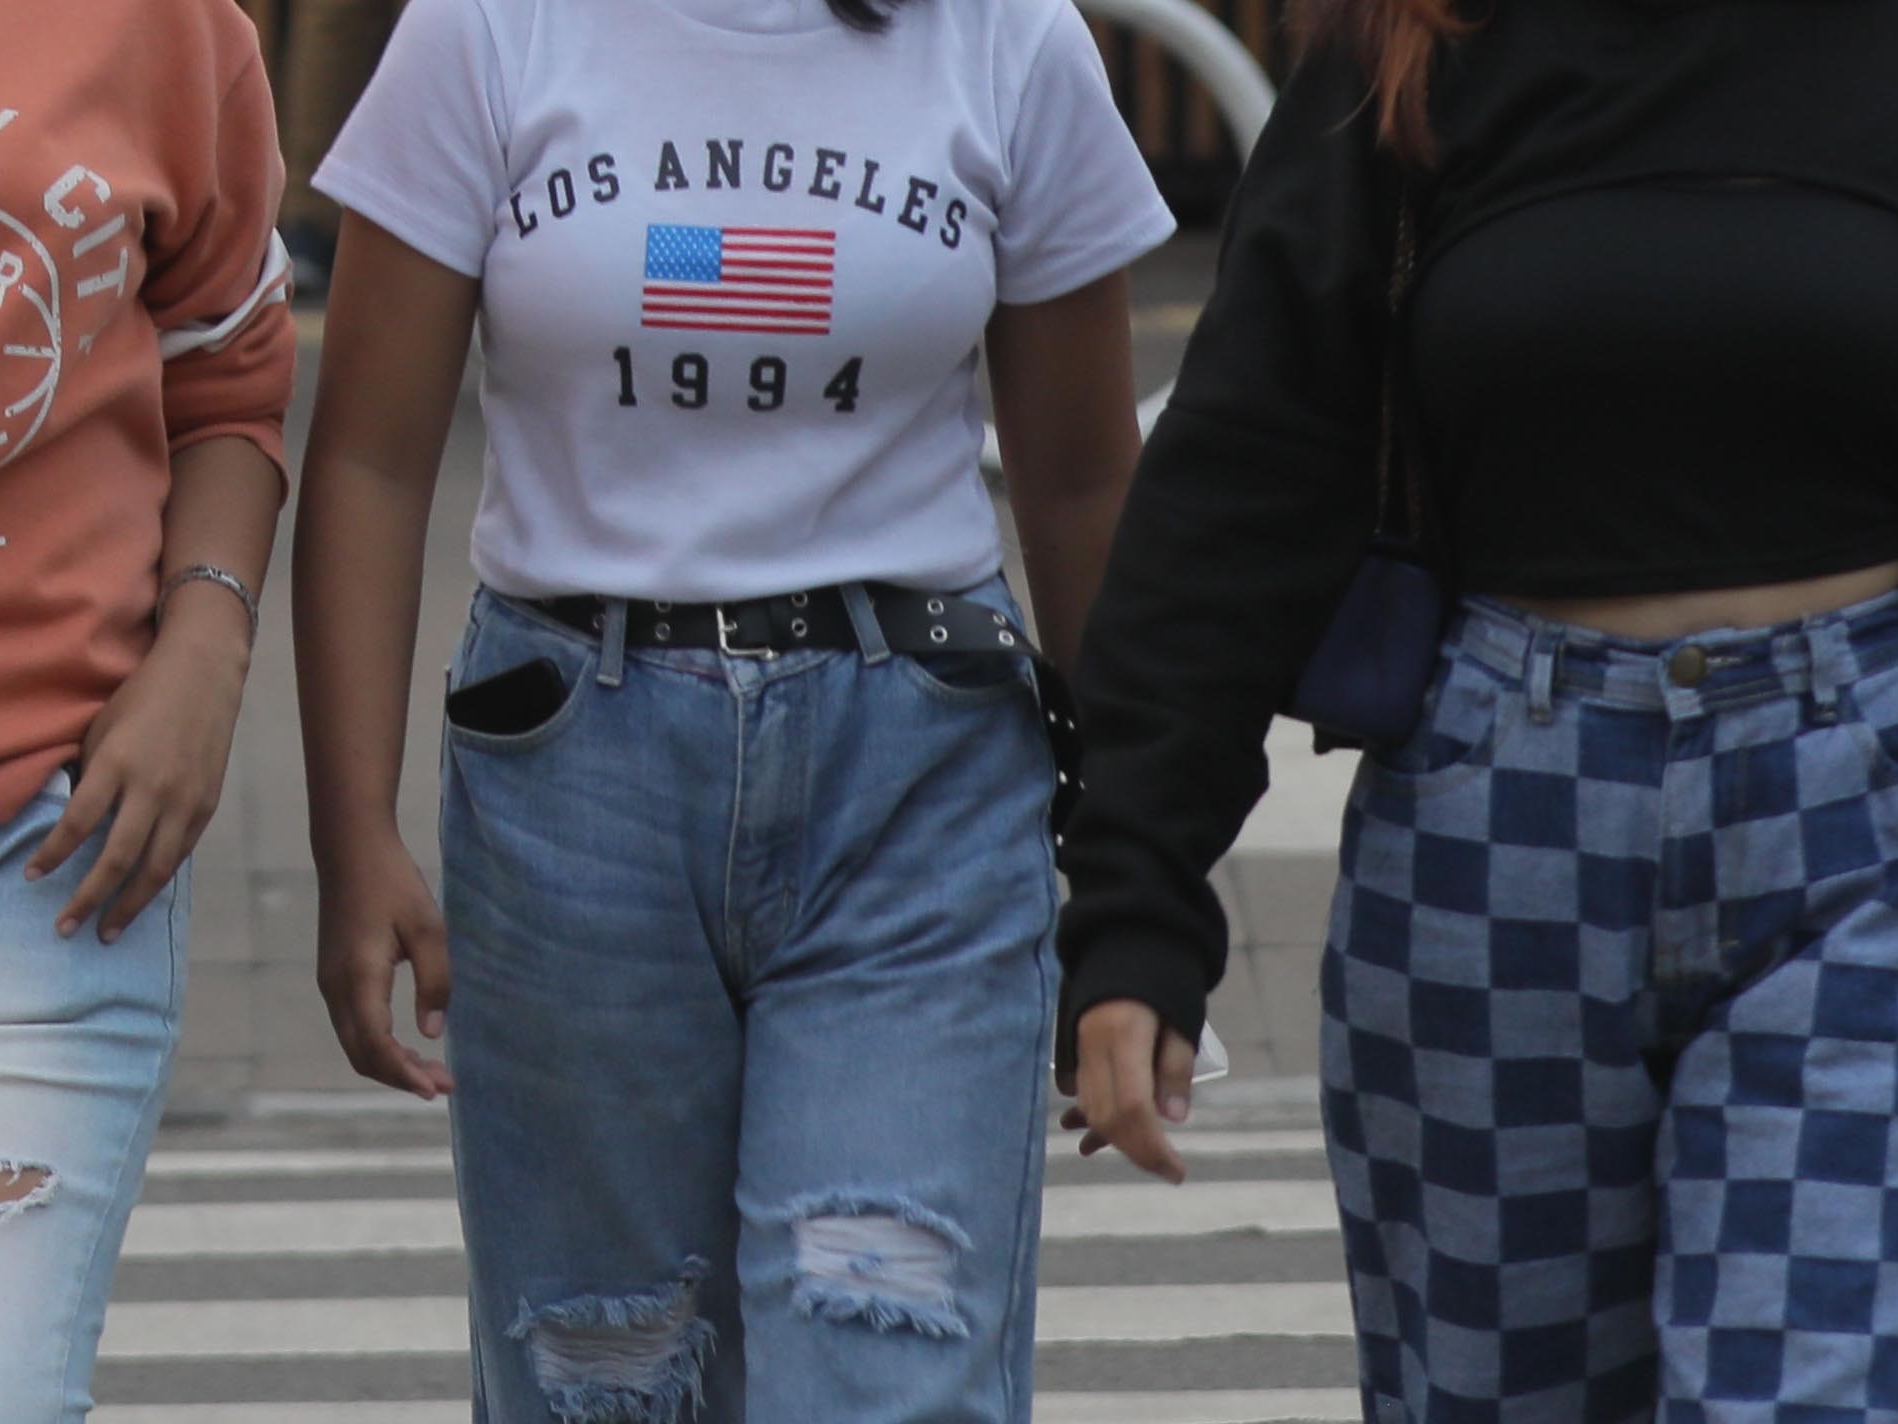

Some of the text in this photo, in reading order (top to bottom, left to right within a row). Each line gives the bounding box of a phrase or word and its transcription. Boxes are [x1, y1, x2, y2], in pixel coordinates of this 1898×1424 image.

[509, 139, 968, 250] LOS ANGELES
[42, 163, 130, 355] CIT
[612, 345, 864, 413] 1994
